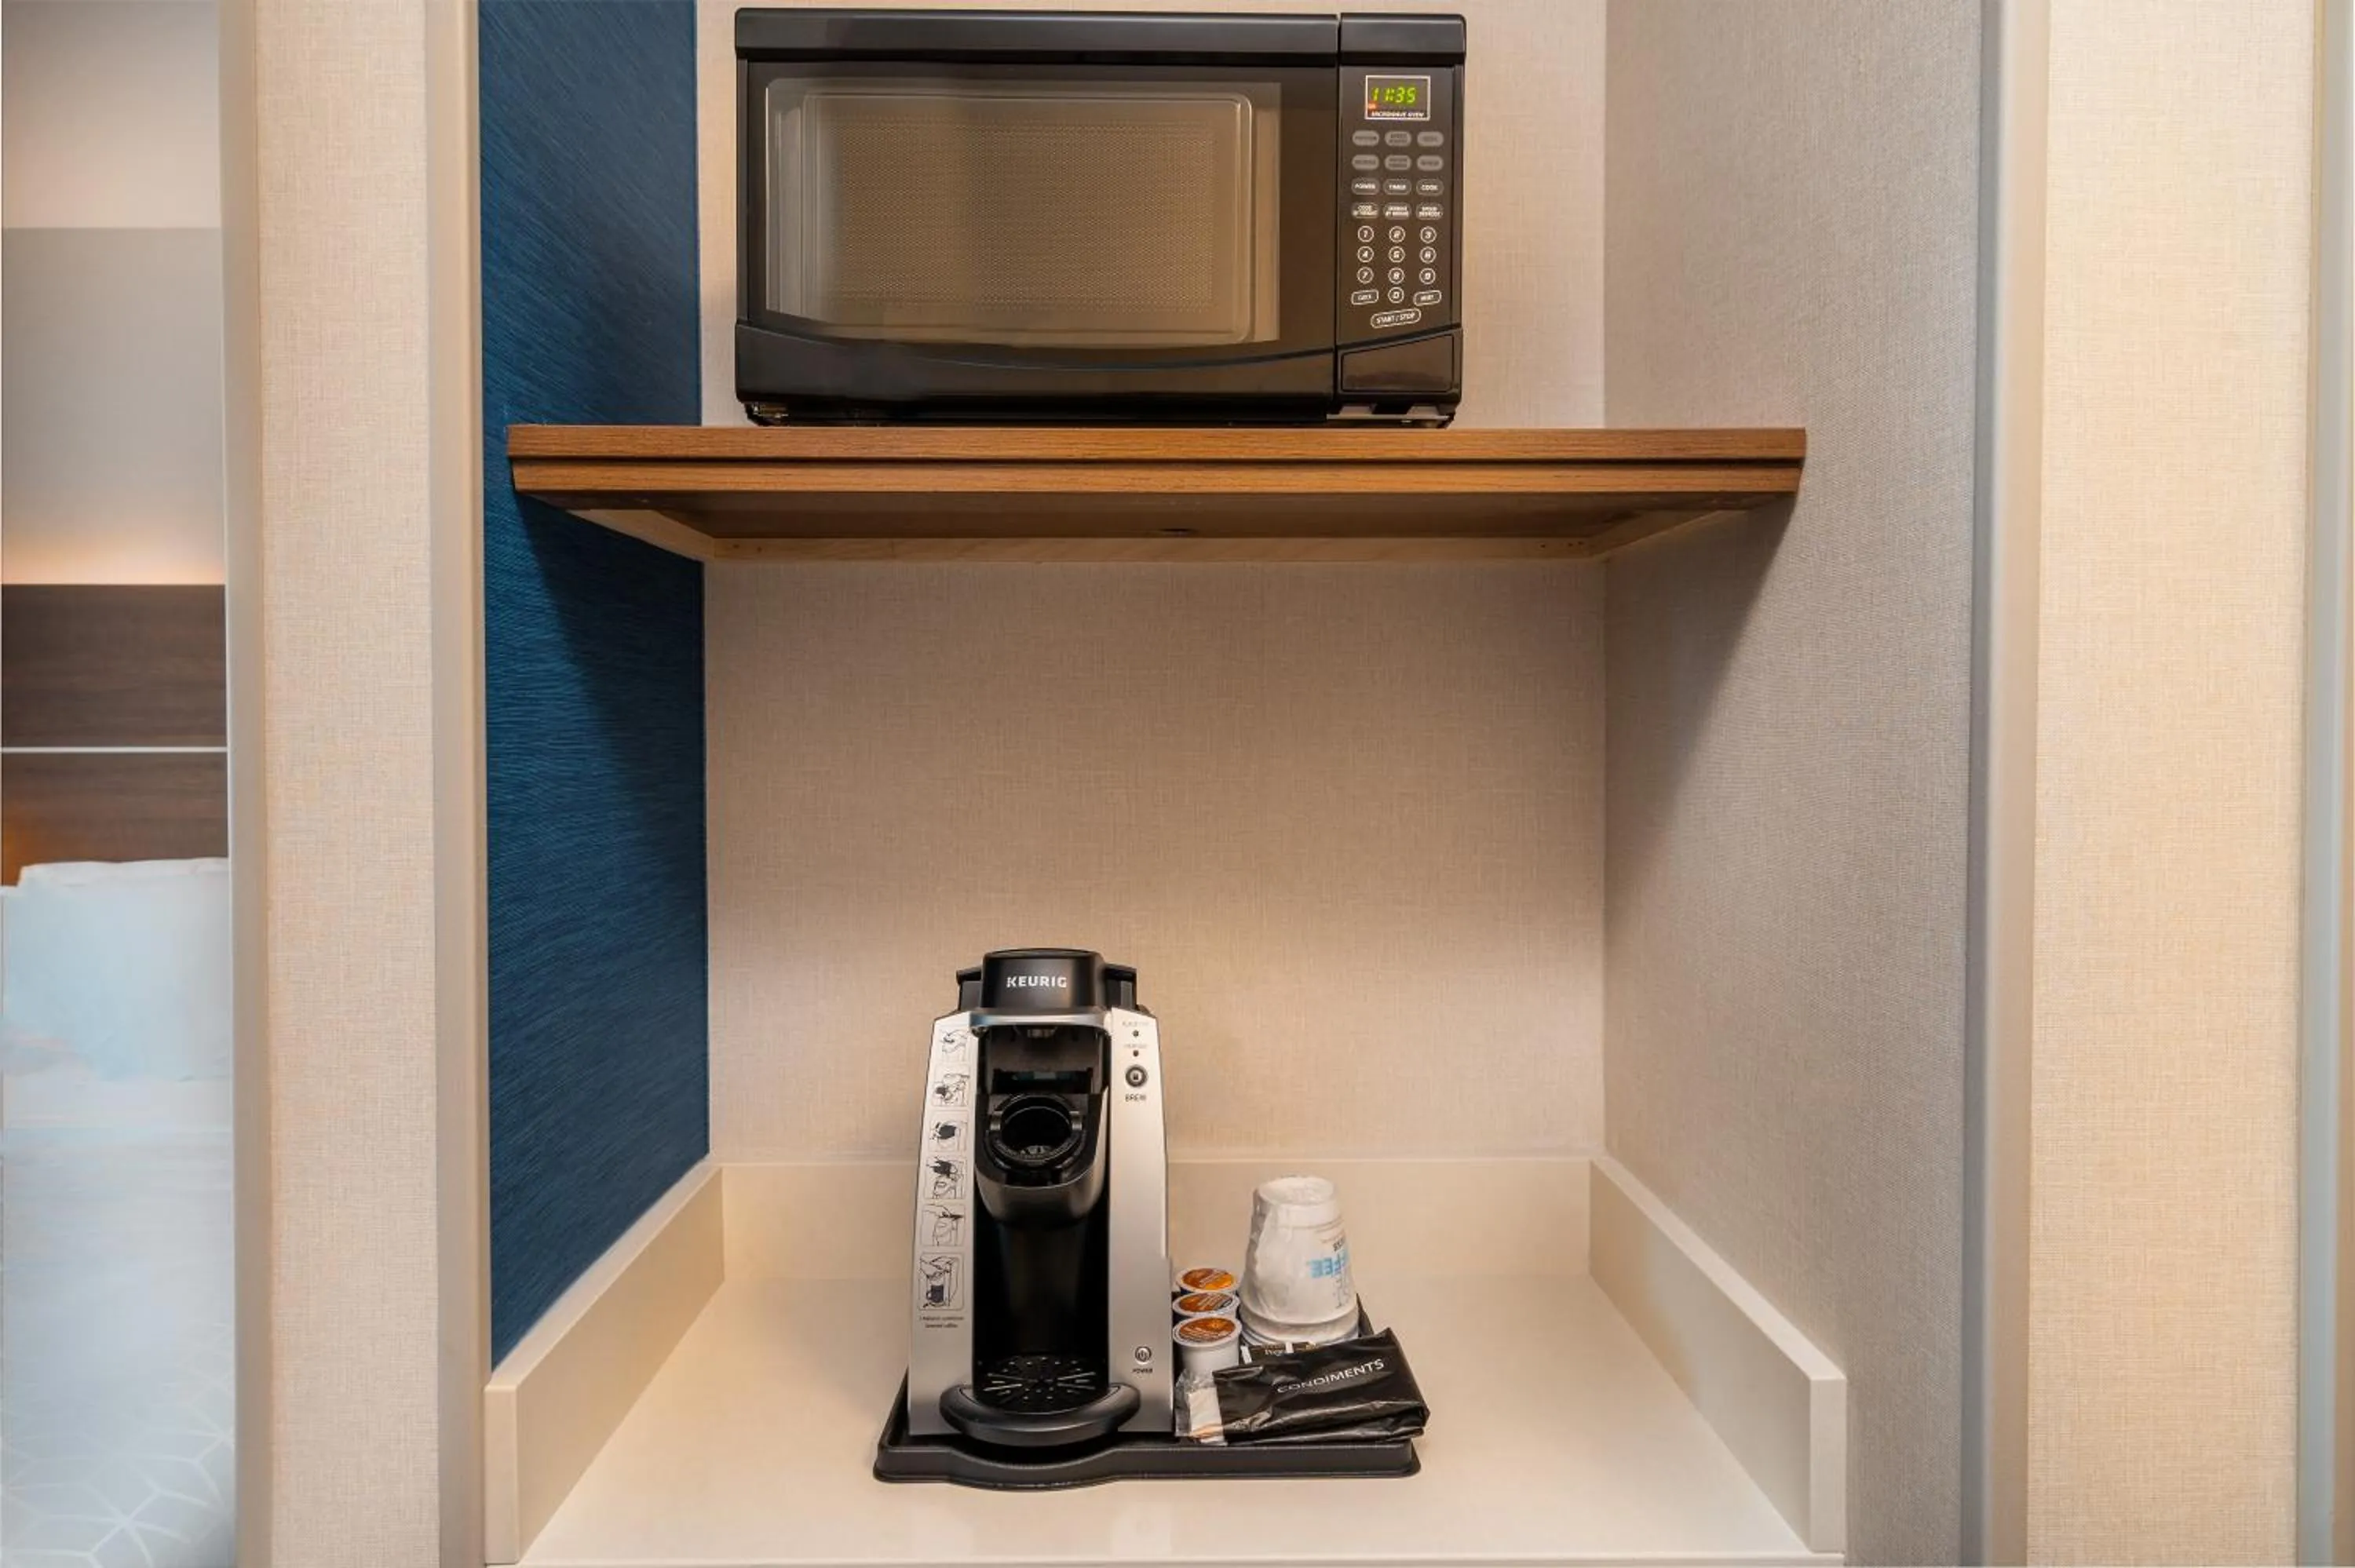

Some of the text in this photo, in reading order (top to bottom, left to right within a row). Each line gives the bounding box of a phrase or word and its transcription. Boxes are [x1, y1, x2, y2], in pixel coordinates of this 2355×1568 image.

[1371, 86, 1417, 103] 11:35
[1006, 975, 1068, 989] KEURIG
[1276, 1358, 1385, 1394] CONDIMENTS
